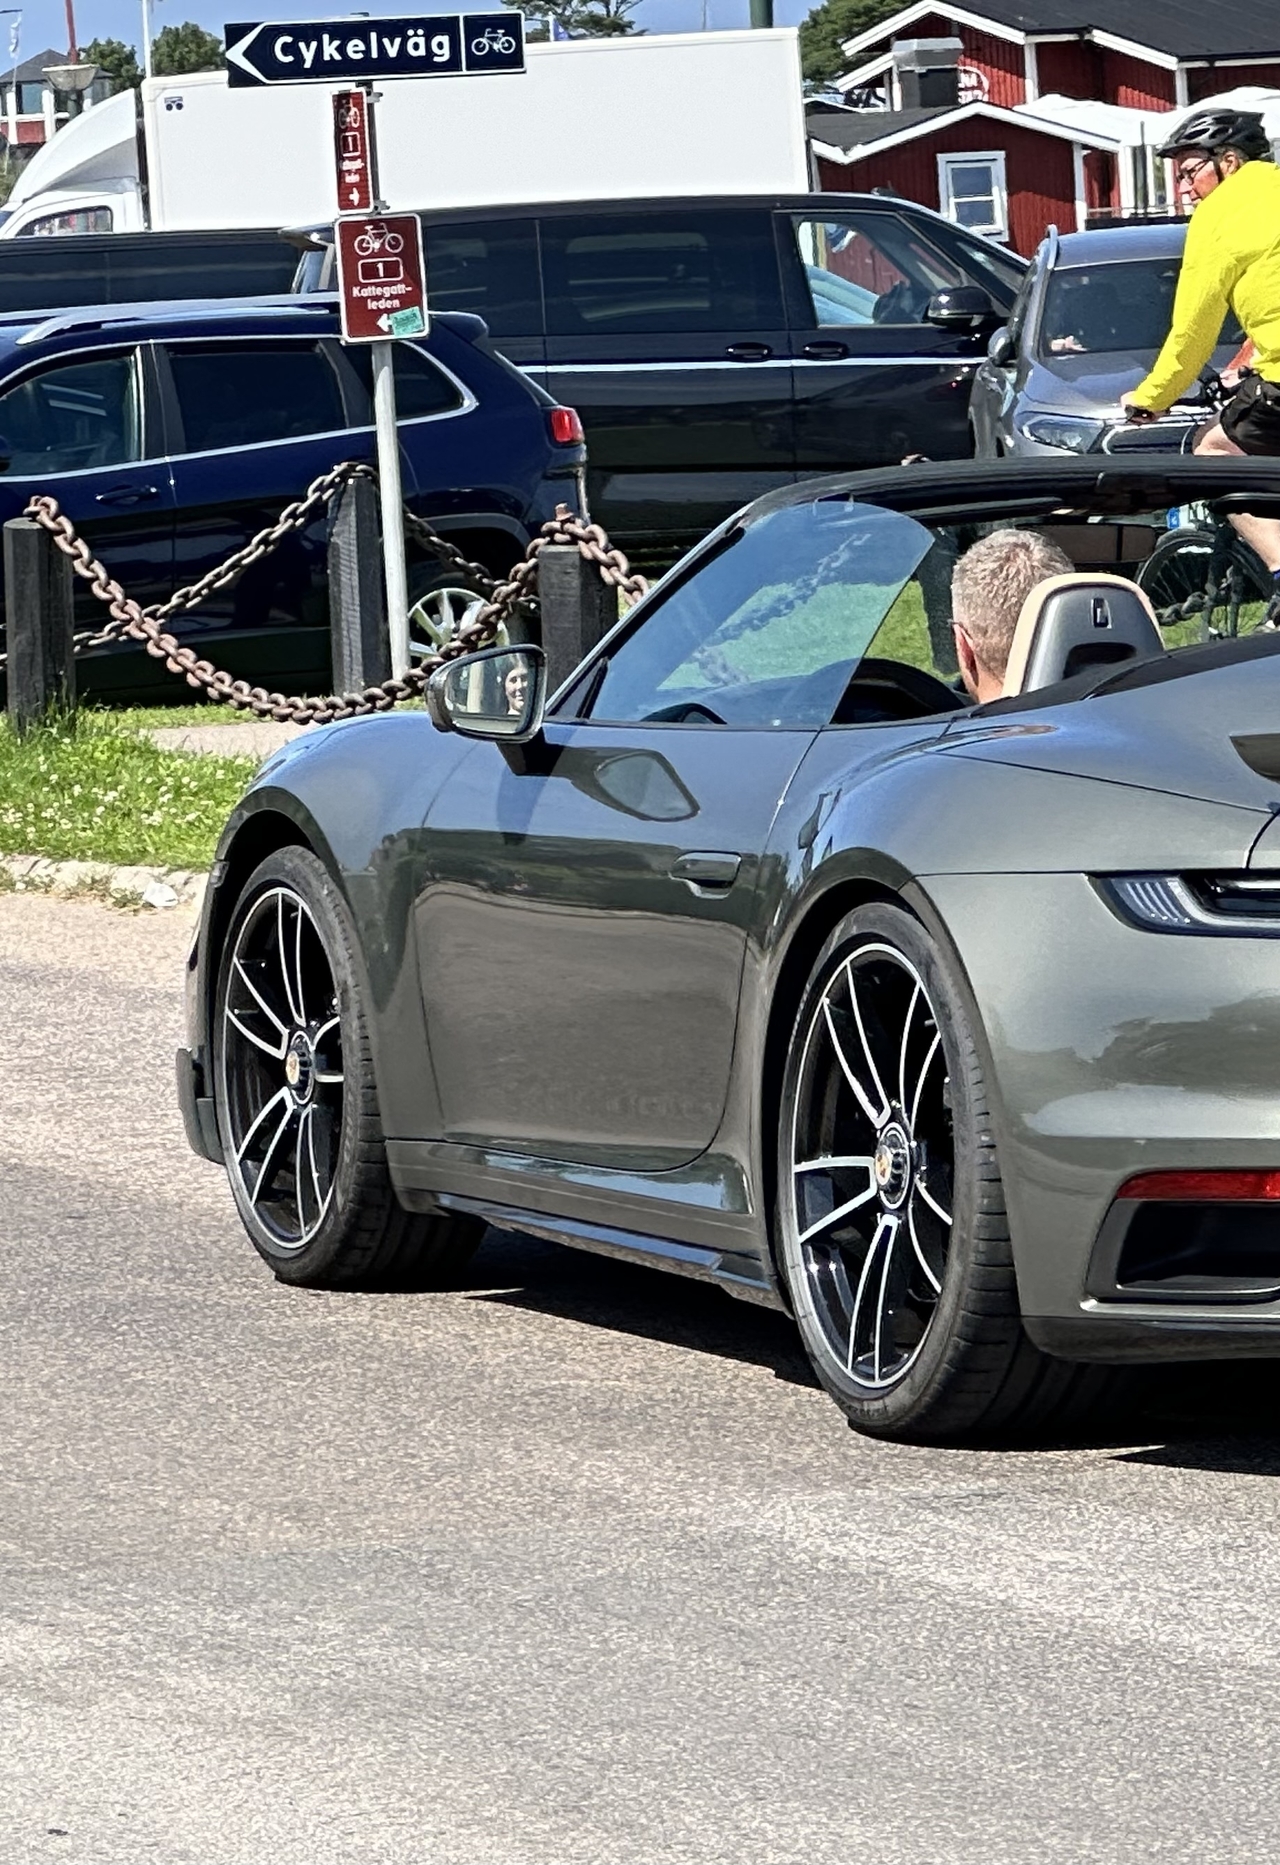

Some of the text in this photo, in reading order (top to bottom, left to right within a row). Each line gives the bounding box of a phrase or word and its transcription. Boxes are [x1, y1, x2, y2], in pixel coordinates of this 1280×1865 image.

[273, 29, 451, 69] Cykelväg
[376, 262, 384, 278] 1
[352, 283, 413, 298] Kattegatt-
[367, 298, 400, 310] leden
